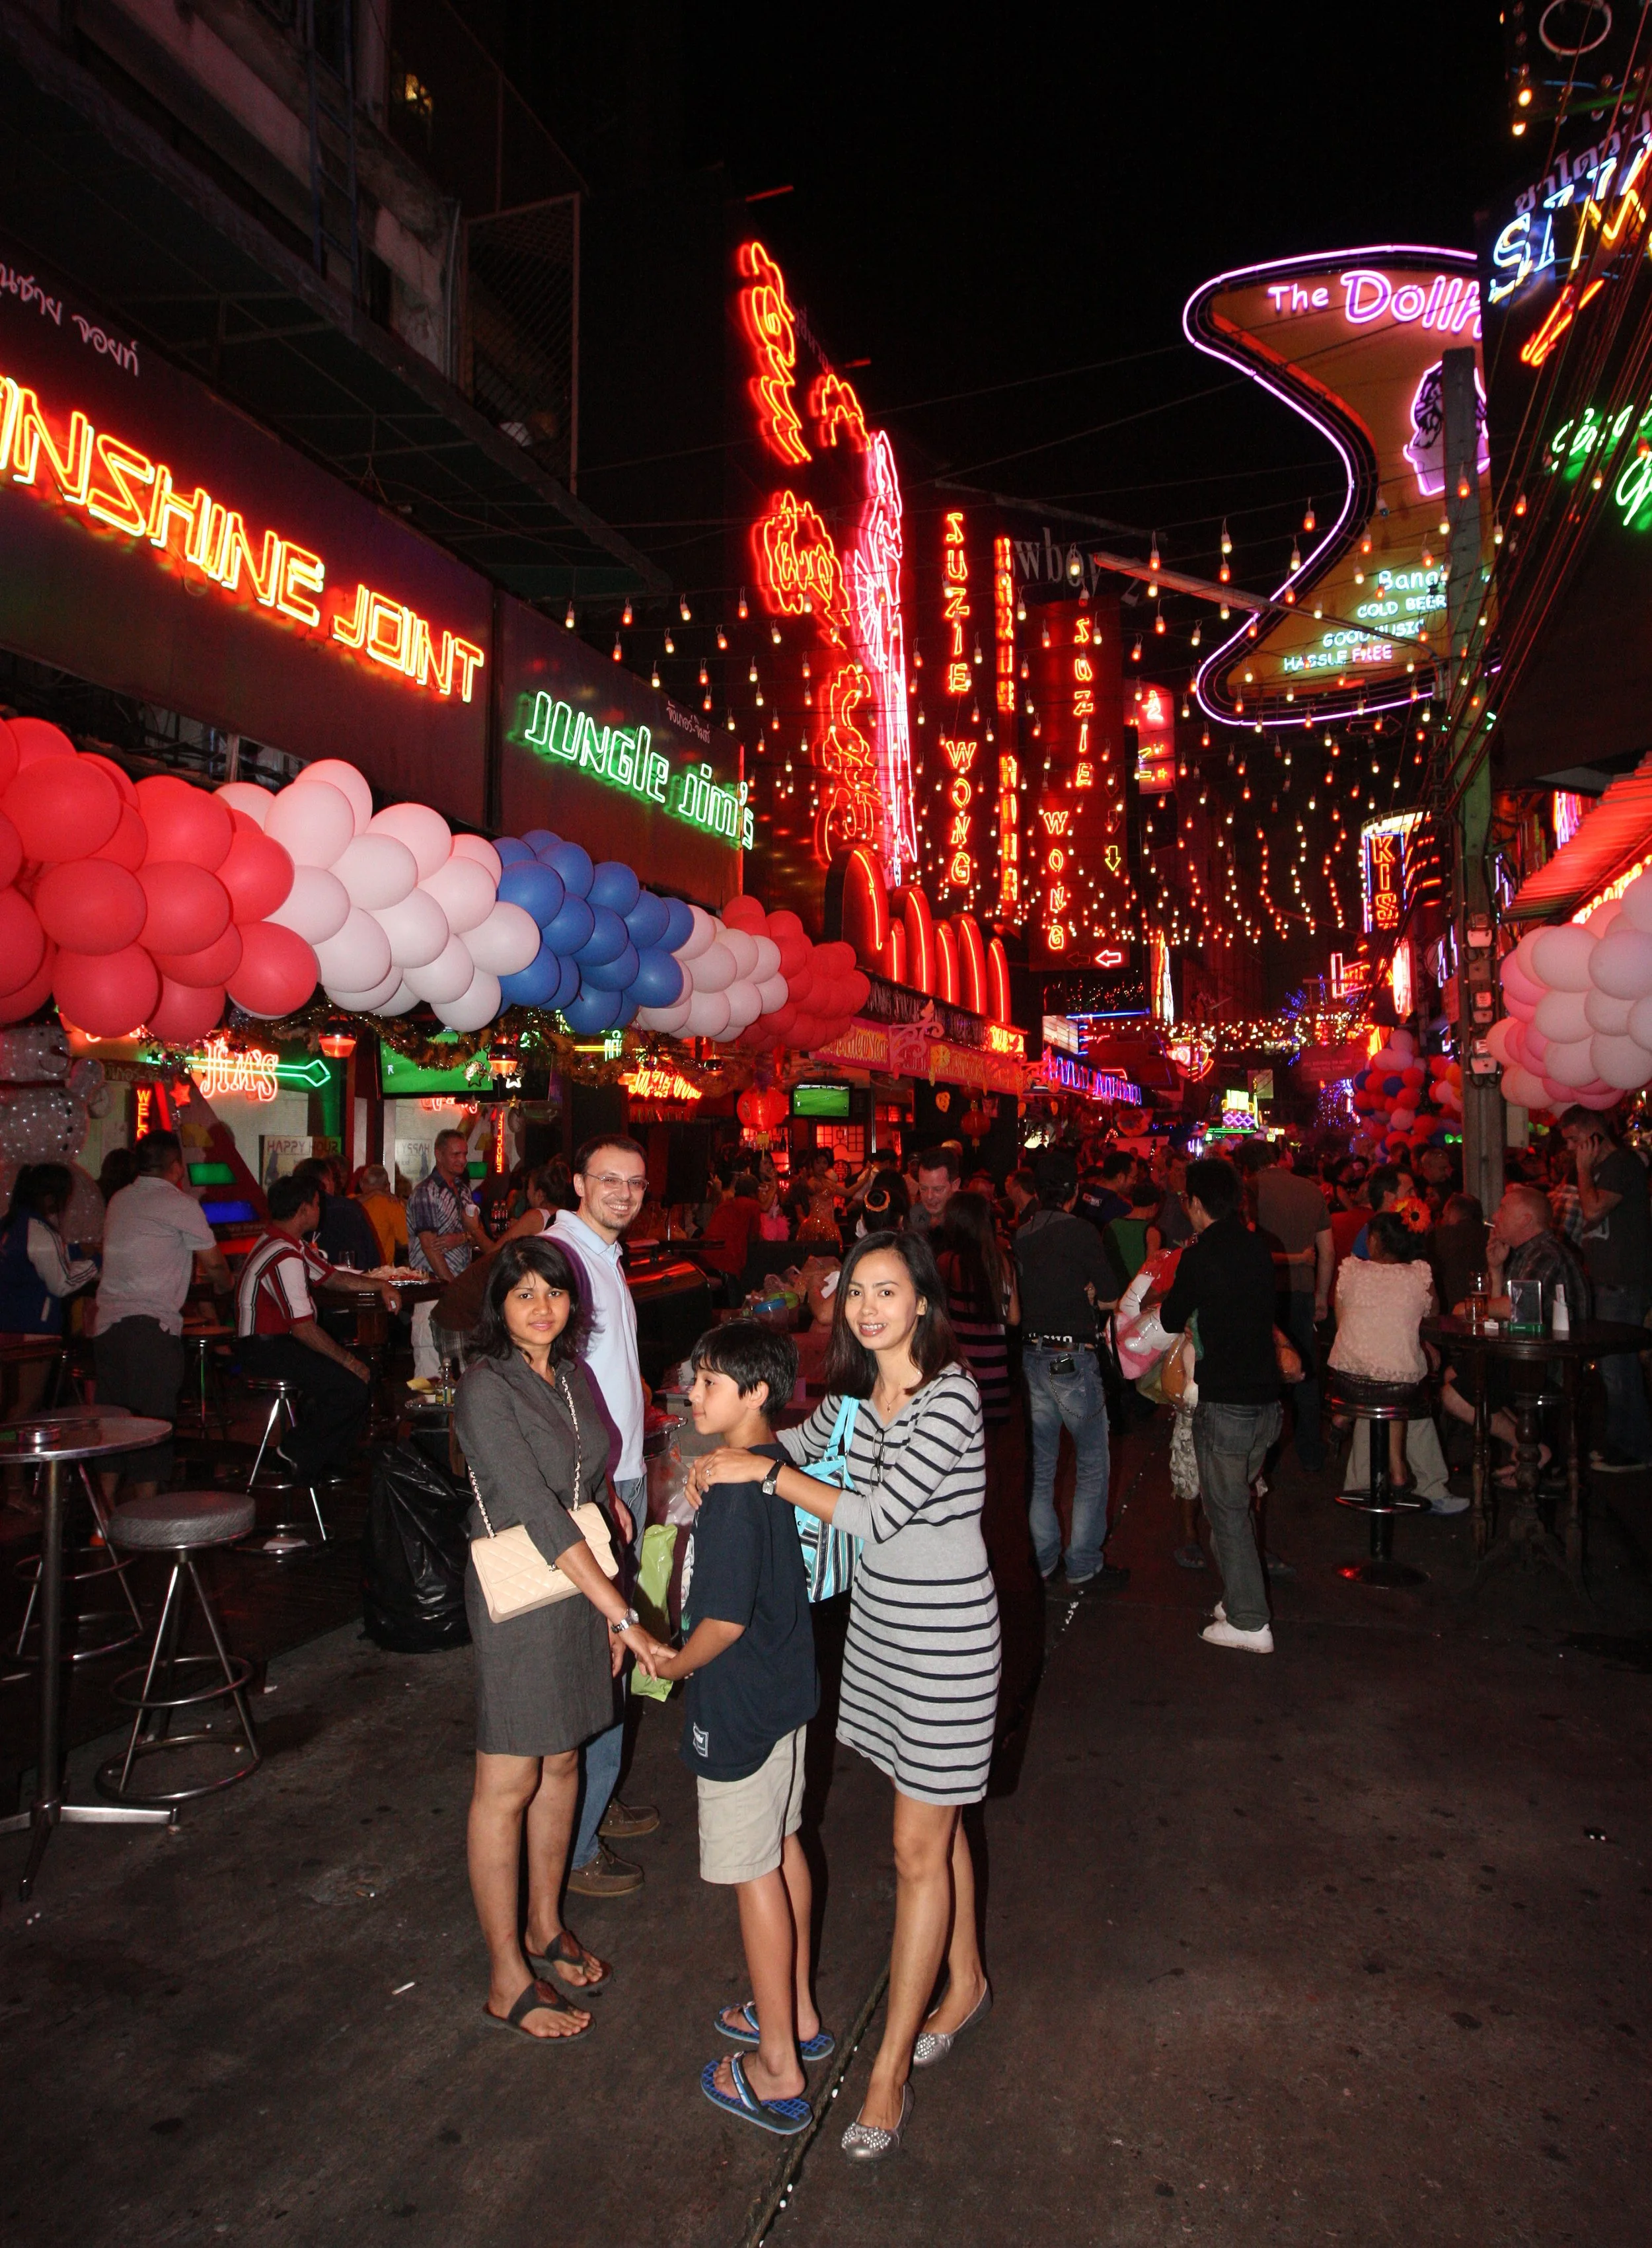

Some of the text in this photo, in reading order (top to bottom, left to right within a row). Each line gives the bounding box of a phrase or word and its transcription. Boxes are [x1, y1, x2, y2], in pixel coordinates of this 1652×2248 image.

[1267, 285, 1330, 315] The
[0, 373, 485, 703] NSHINE JOINT
[1357, 594, 1448, 620] COLD BEER
[1283, 644, 1393, 672] HASSLE FREE
[944, 512, 977, 886] SUZIE WONG
[1041, 617, 1094, 951] SUZIE WONG
[309, 1141, 338, 1152] HOUR
